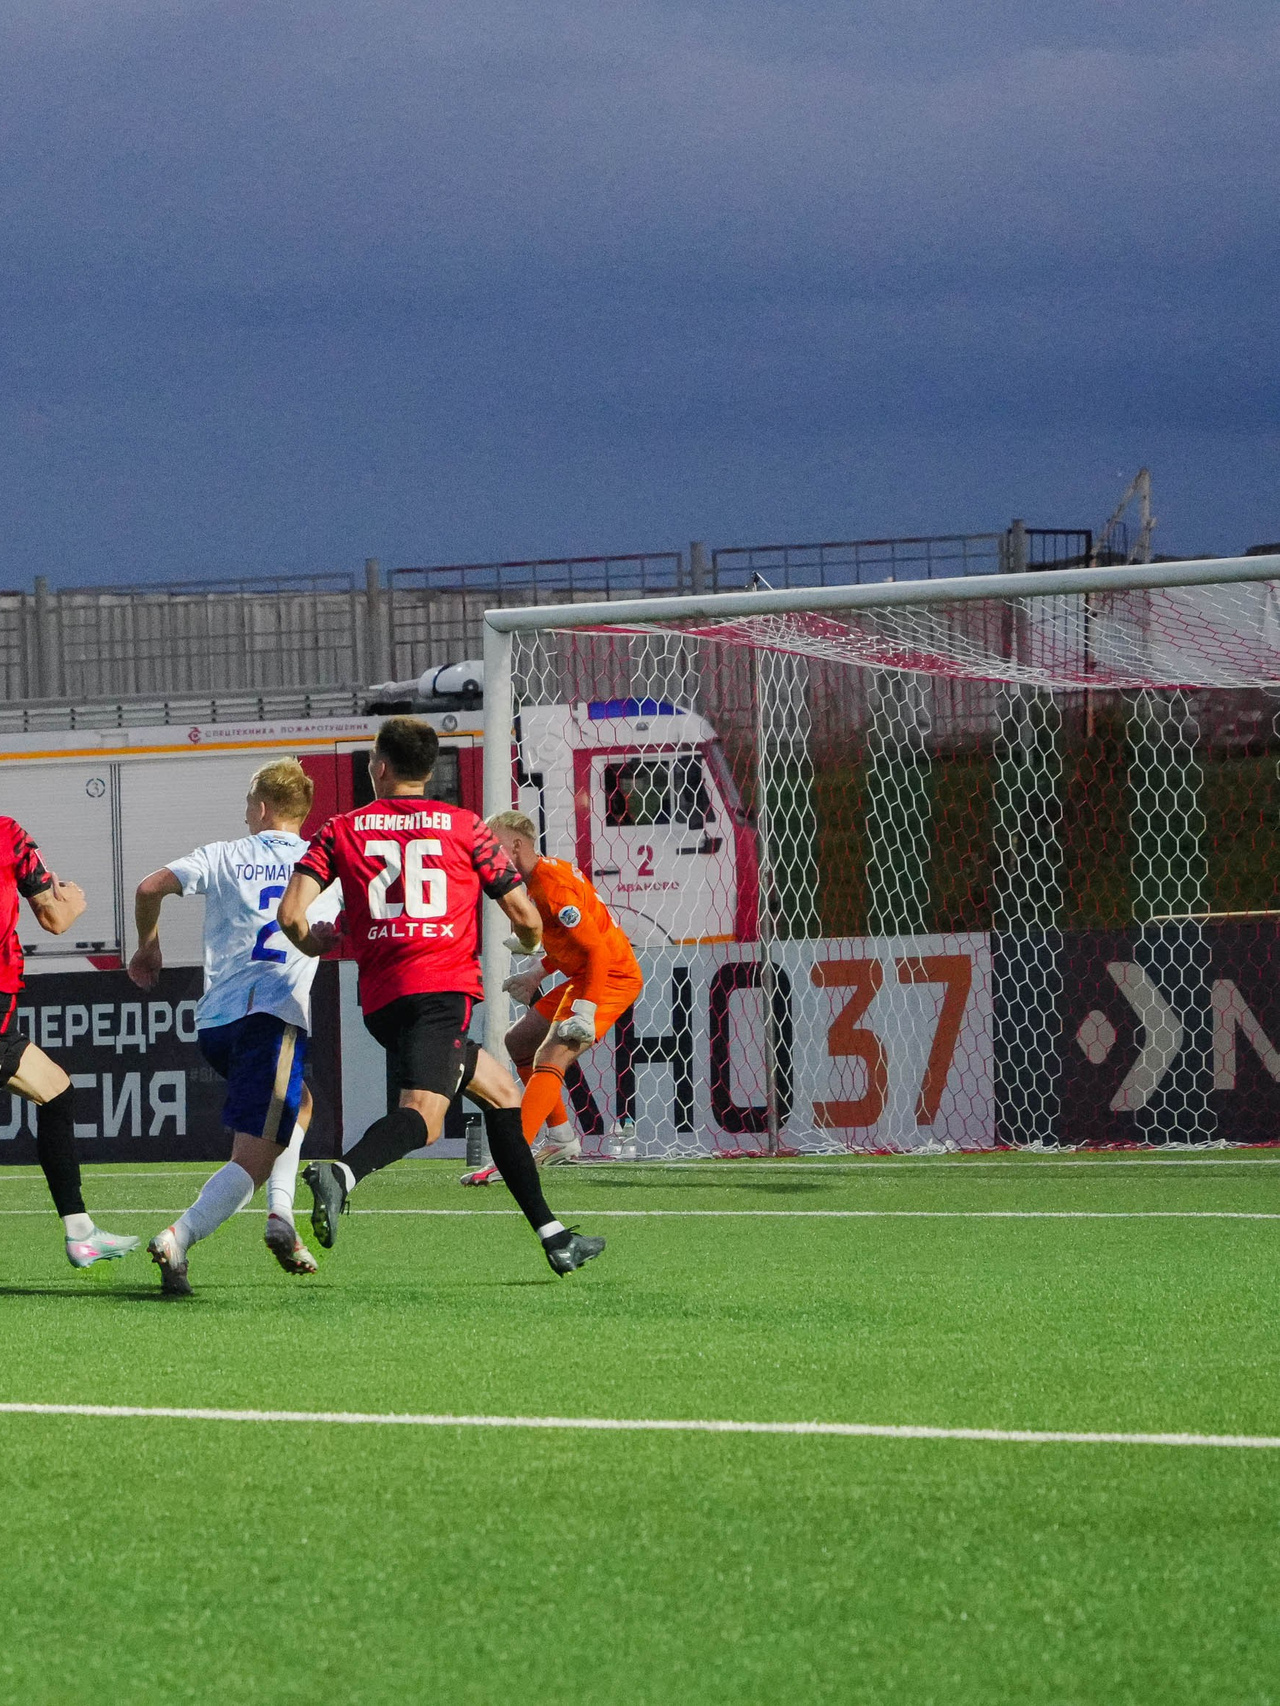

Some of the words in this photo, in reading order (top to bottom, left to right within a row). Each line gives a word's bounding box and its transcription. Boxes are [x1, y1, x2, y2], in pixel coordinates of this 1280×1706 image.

[354, 811, 452, 831] КЛЕМЕНТЬЕВ
[235, 863, 291, 881] ТОРМА
[637, 844, 654, 876] 2
[364, 838, 448, 919] 26
[251, 885, 288, 964] 2
[367, 922, 454, 940] GALTEX
[17, 1000, 198, 1055] ПЕРЕДРО
